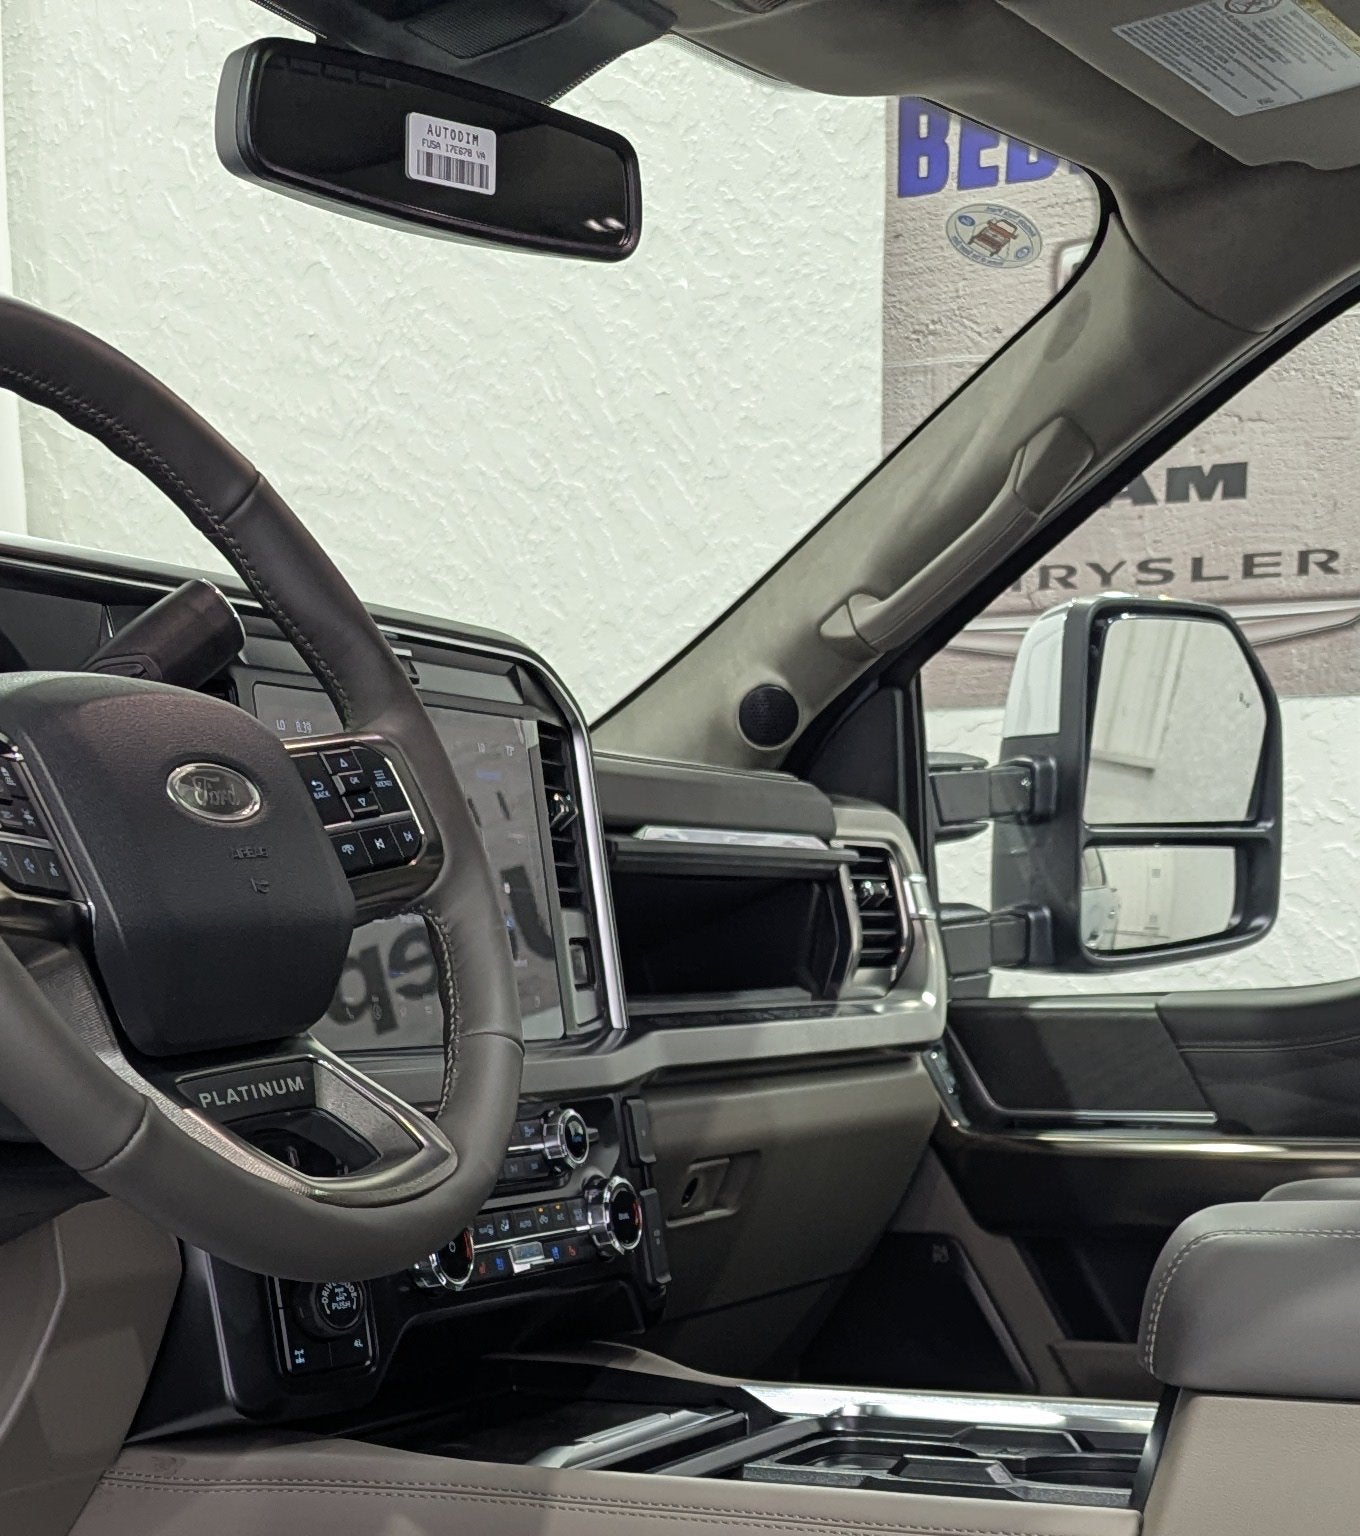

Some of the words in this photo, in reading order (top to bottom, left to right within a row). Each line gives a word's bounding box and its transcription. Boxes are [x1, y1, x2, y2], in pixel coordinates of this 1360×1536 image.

[427, 123, 479, 147] AUTODIM
[1010, 549, 1341, 594] RYSLER
[198, 1075, 305, 1109] PLATINUM
